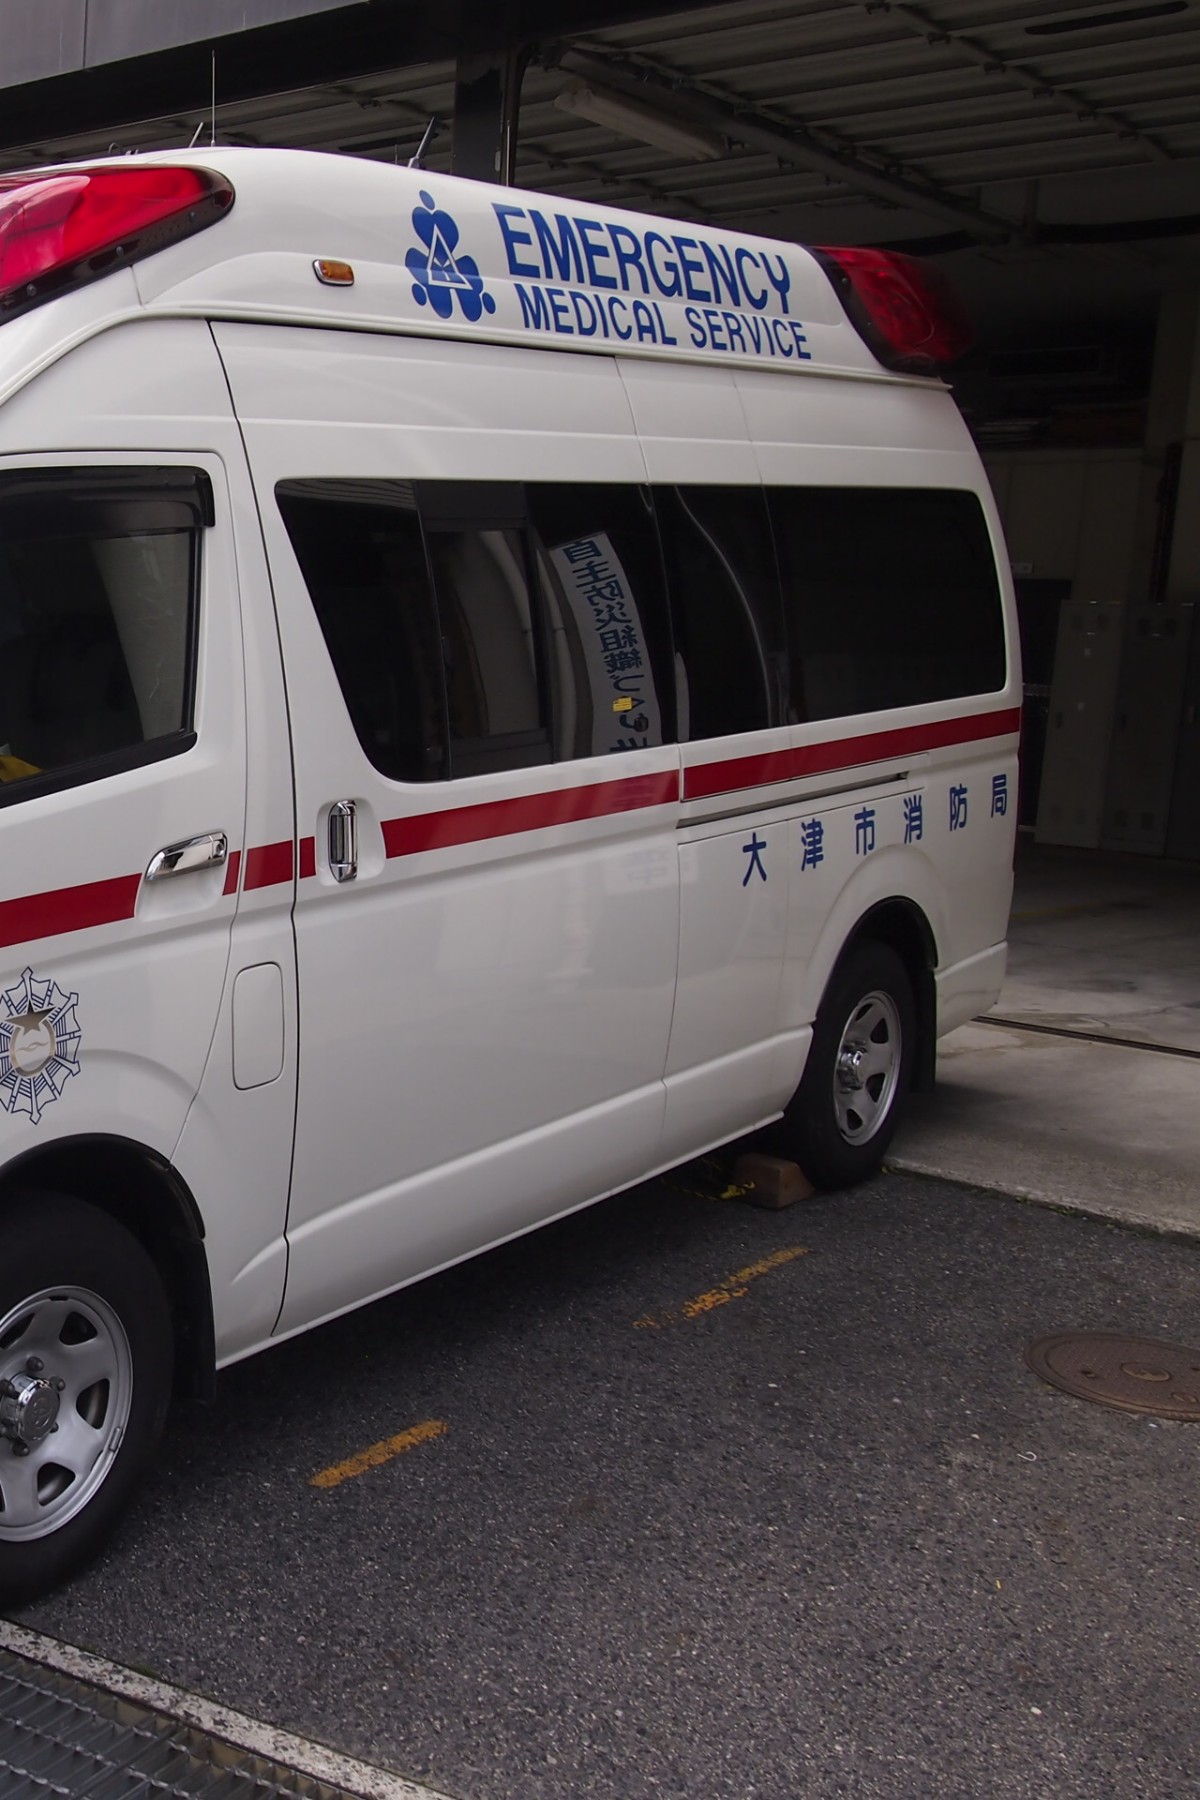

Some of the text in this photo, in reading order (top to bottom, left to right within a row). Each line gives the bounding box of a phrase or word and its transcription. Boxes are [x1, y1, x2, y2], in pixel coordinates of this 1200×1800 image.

[491, 202, 791, 314] EMERGENCY
[514, 283, 812, 360] MEDICAL SERVICE
[742, 773, 1008, 888] 大津市消防局
